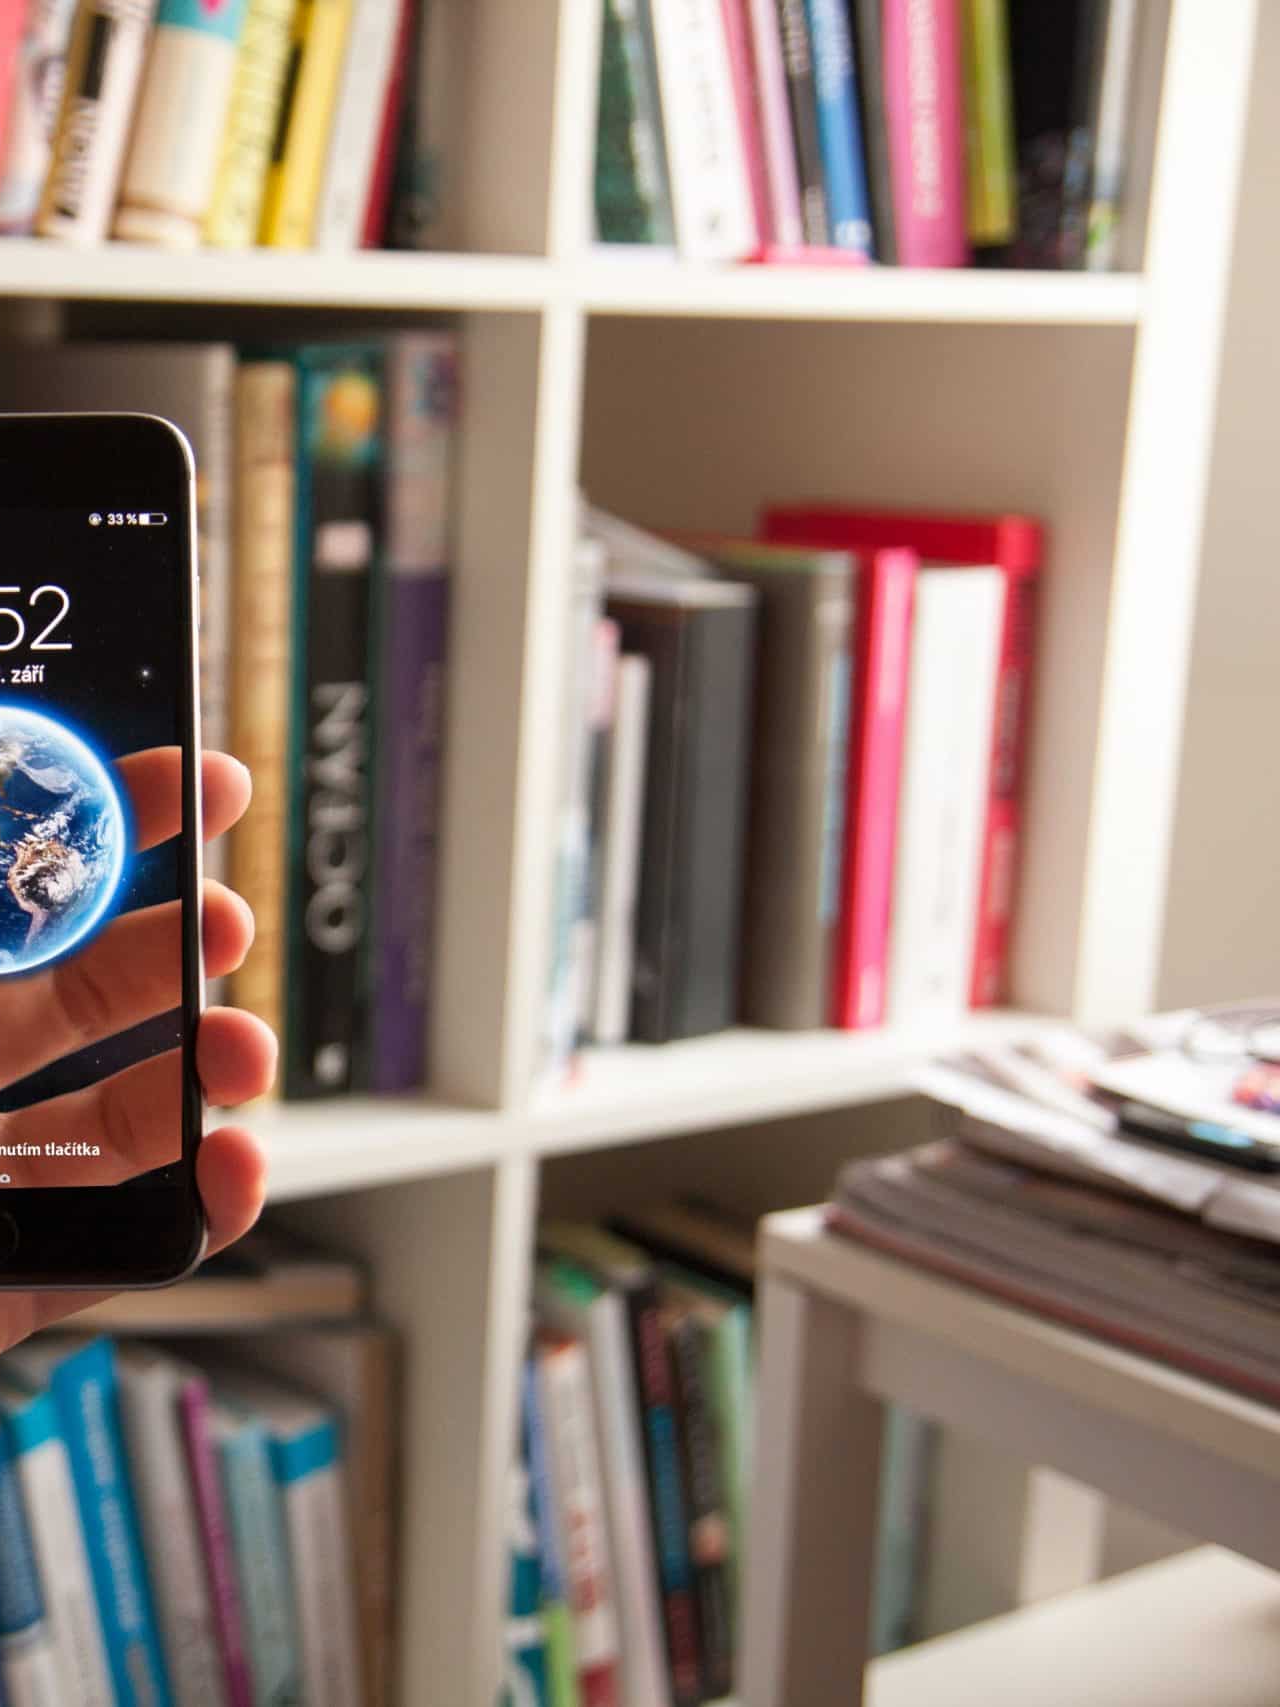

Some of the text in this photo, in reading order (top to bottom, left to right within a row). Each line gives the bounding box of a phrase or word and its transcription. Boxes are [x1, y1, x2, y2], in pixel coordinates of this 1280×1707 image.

[107, 513, 137, 526] 33 %
[11, 664, 45, 683] září
[45, 1142, 101, 1156] tlačítka
